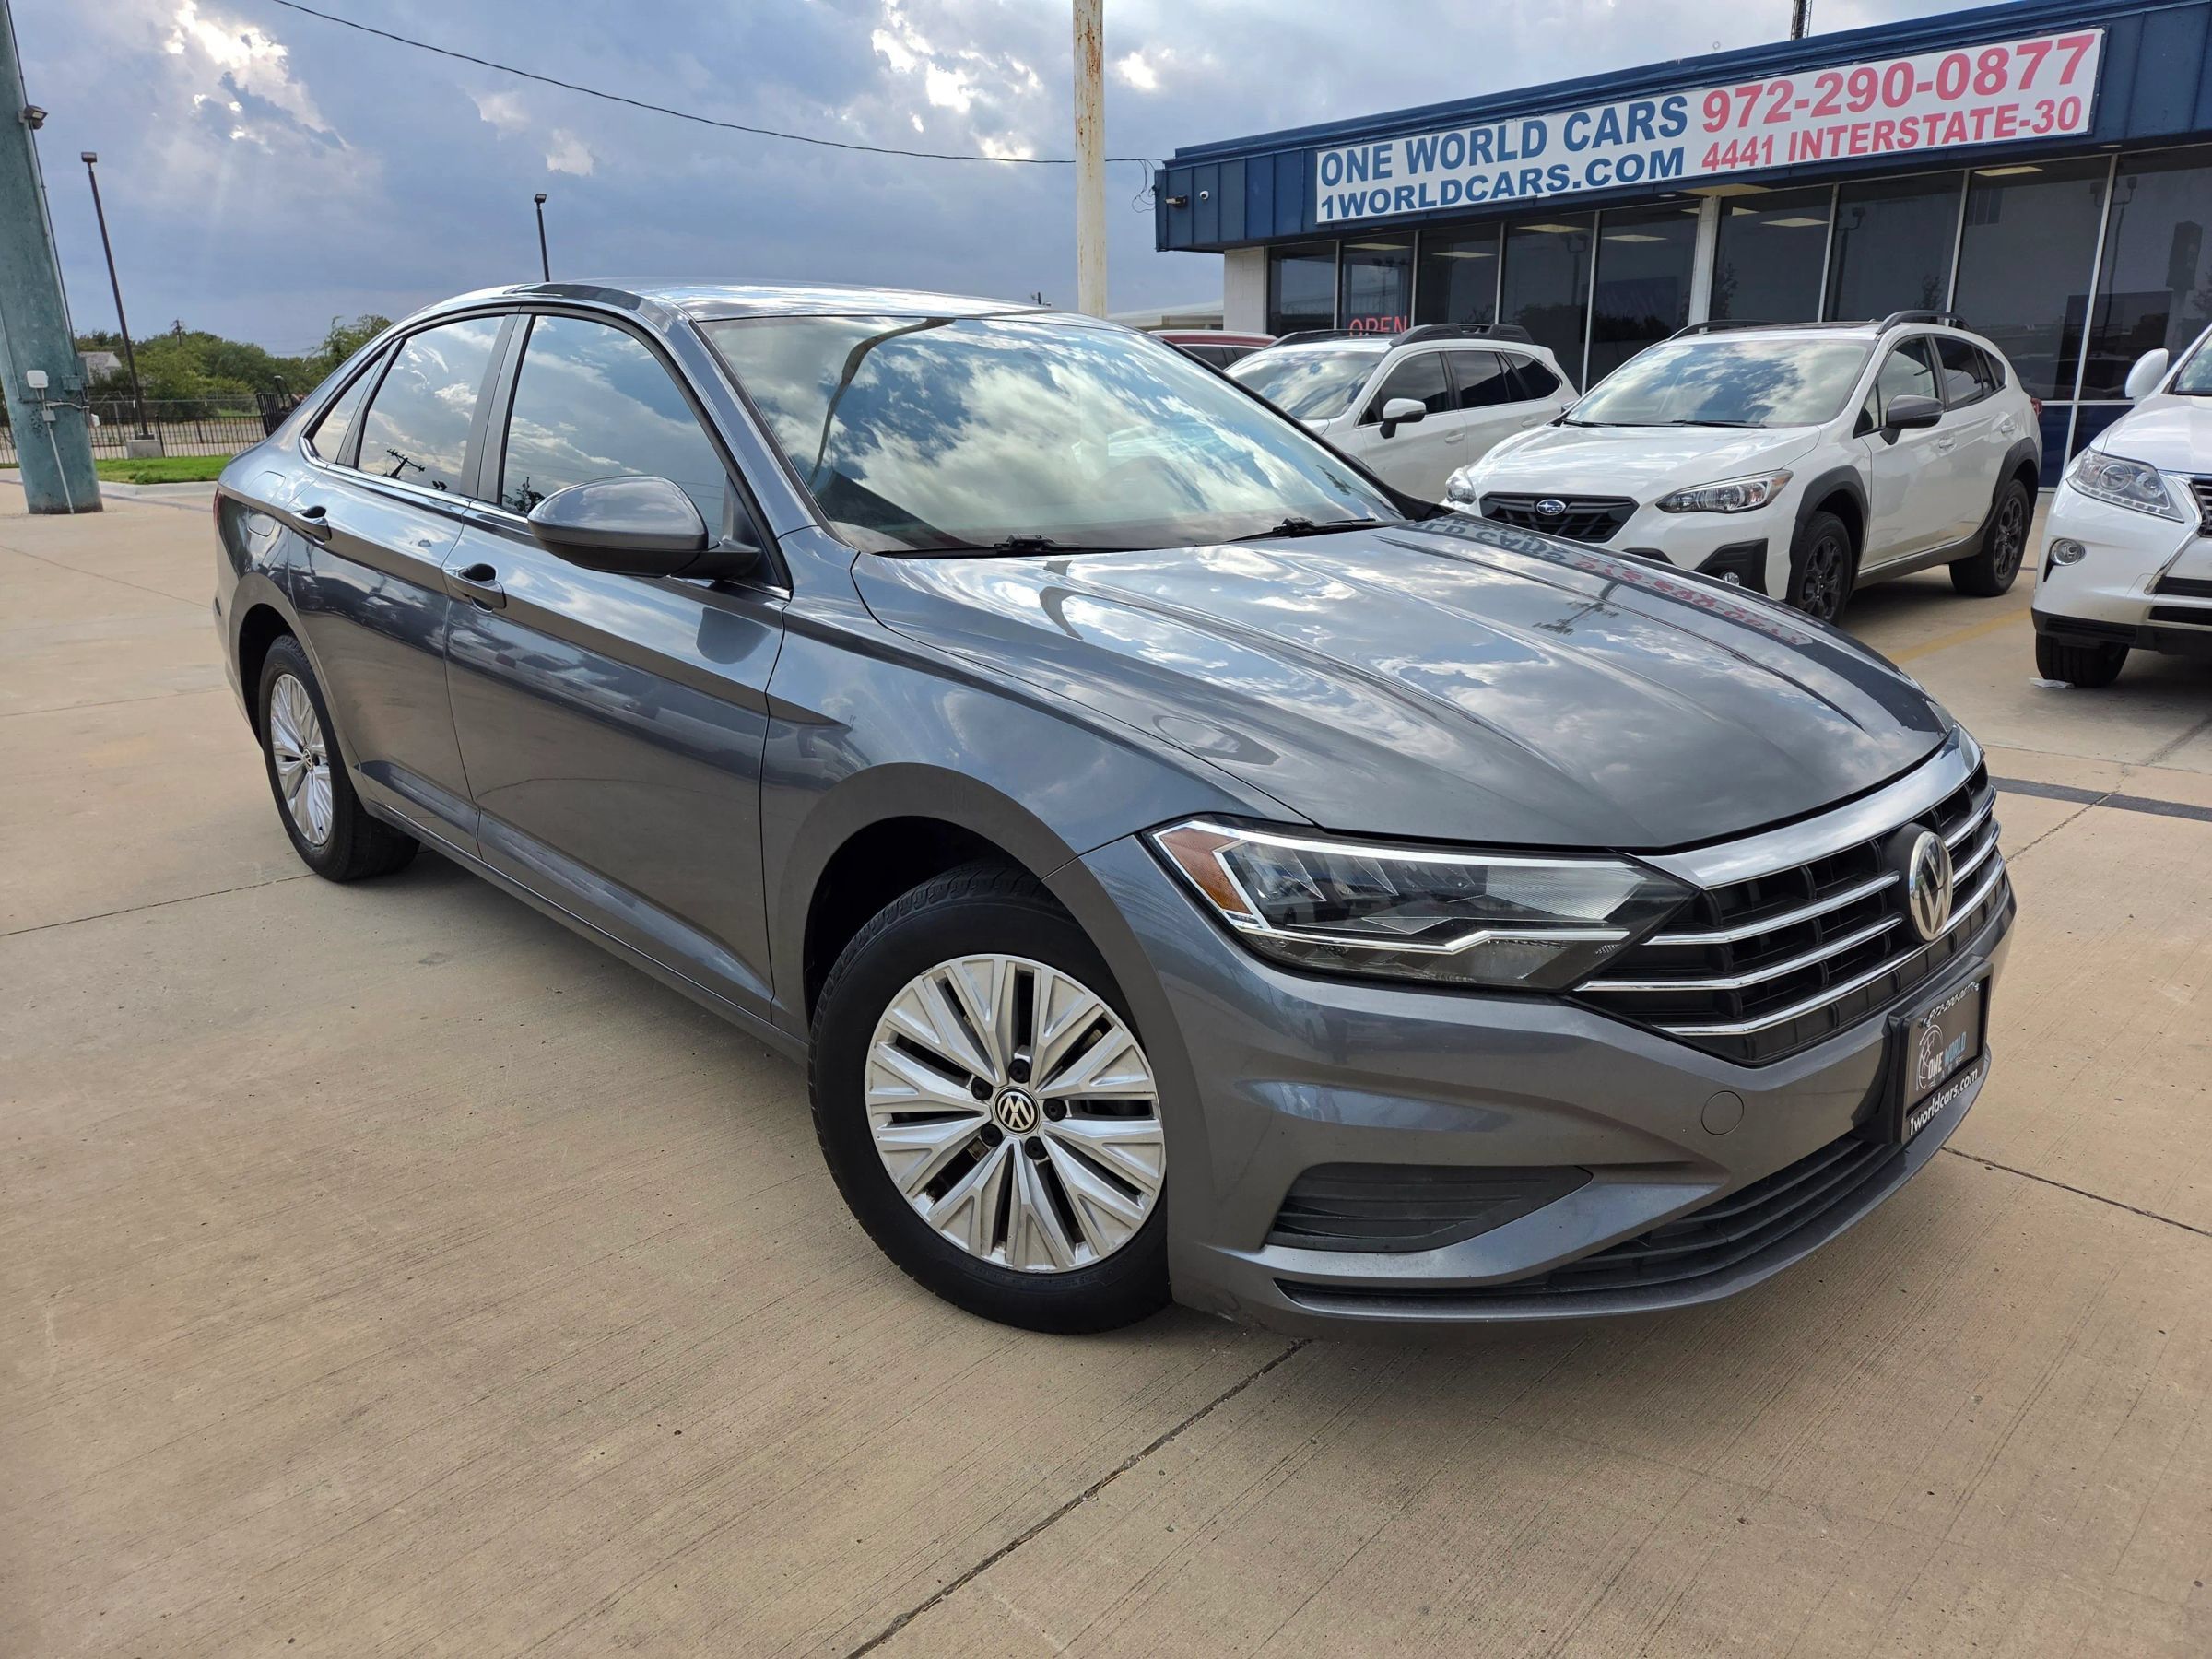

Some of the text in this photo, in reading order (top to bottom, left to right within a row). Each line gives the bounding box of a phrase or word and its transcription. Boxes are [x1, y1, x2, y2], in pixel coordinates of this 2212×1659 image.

[1702, 33, 2096, 134] 972-290-0877
[1321, 95, 1688, 187] ONE WORLD CARS
[1701, 95, 2082, 172] 4441 INTERSTATE-30
[1321, 147, 1685, 220] 1WORLDCARS.COM
[1349, 315, 1407, 337] OPEN
[1927, 1031, 1967, 1080] ONE WORLD
[1910, 1068, 1978, 1136] 1worldcars.com
